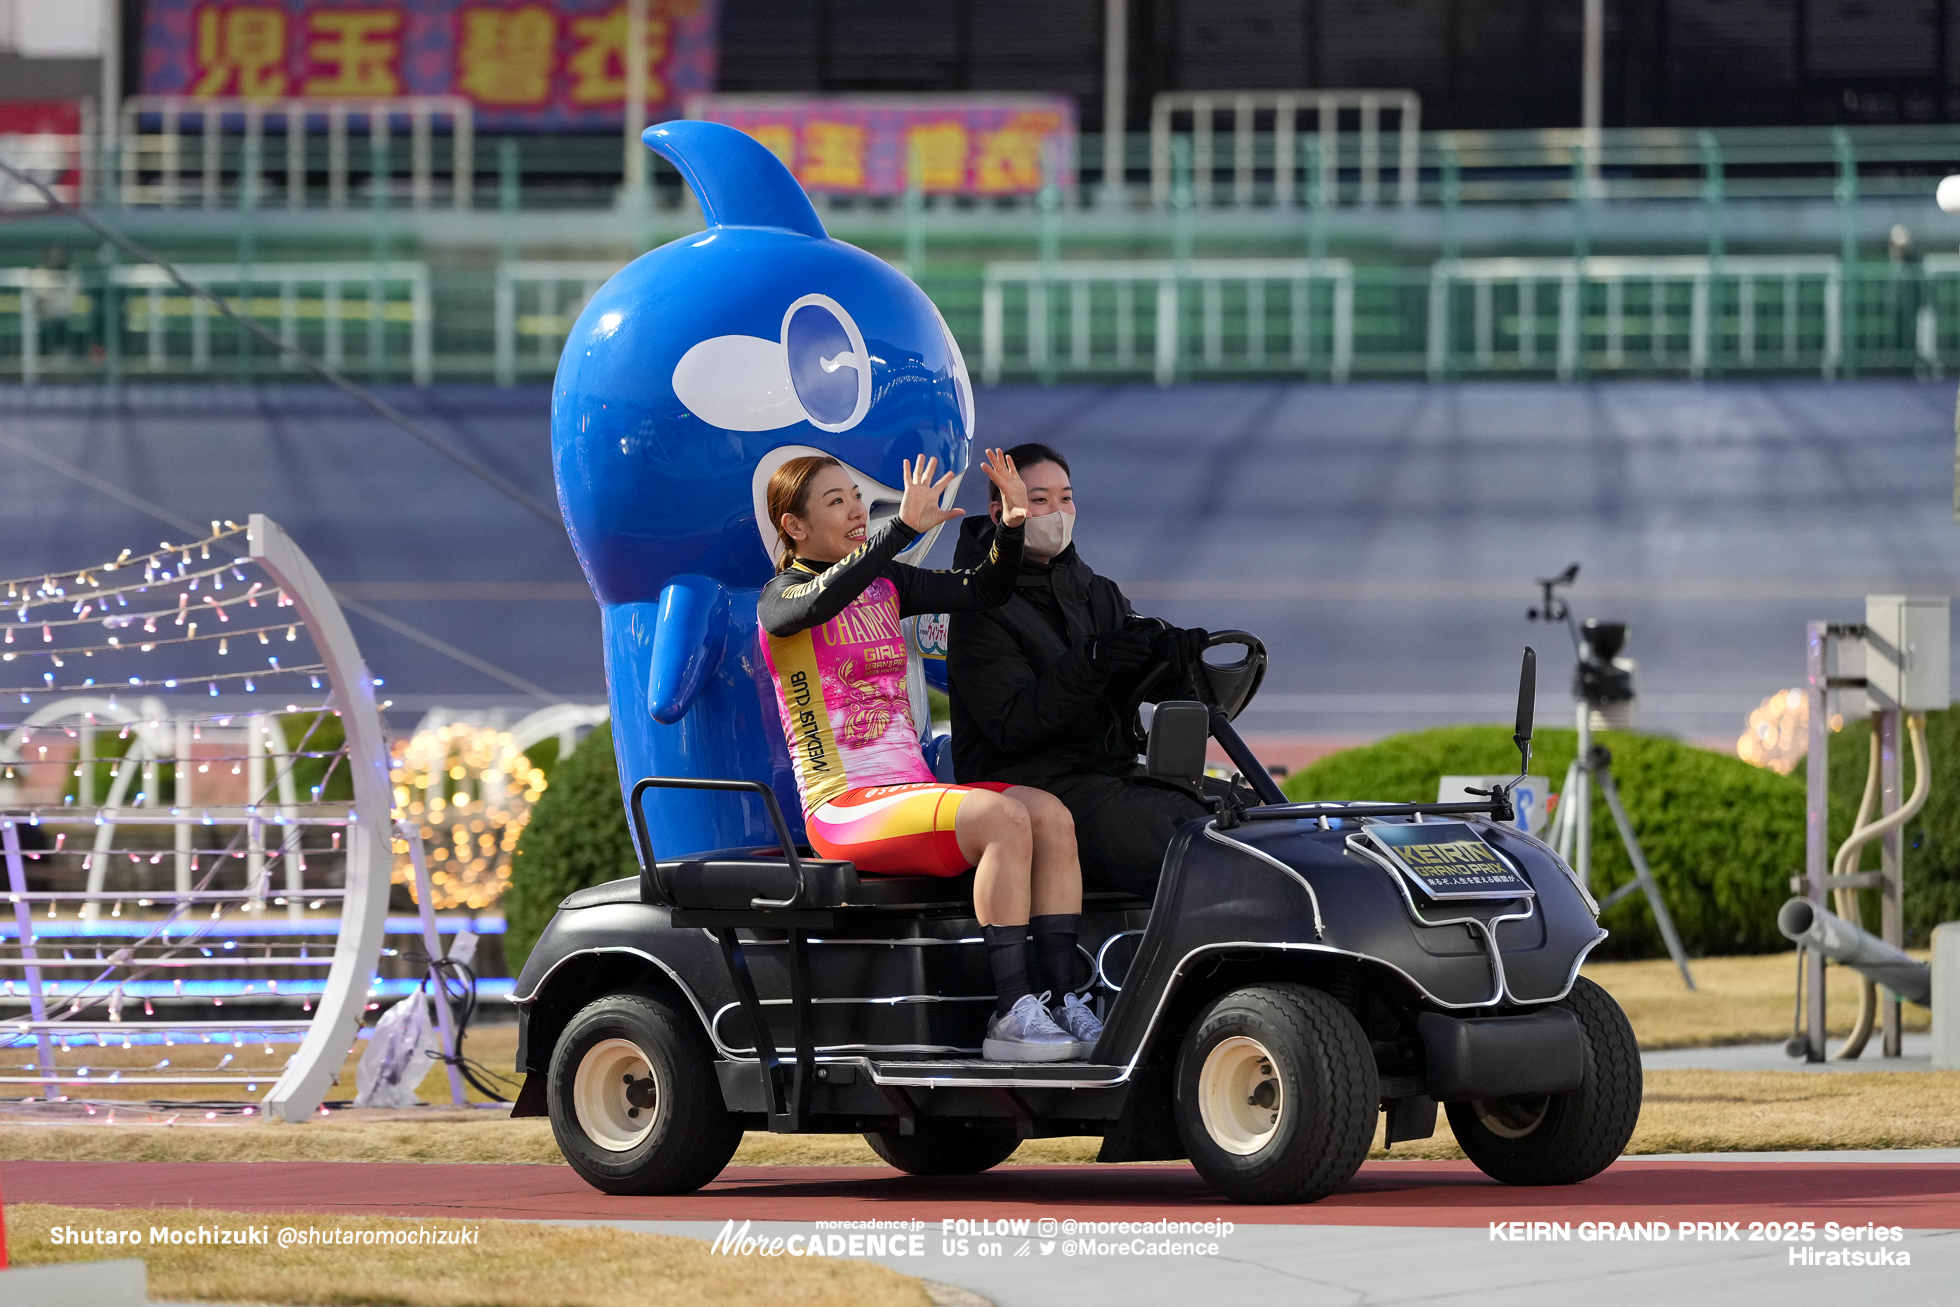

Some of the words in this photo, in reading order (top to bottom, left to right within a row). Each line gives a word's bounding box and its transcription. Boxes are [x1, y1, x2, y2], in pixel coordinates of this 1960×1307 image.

[864, 643, 907, 662] GIRLS
[791, 671, 811, 707] CLUB
[800, 710, 830, 772] MEDALIST
[1392, 843, 1496, 865] KEIRIN
[1413, 865, 1472, 877] GRAND
[1470, 862, 1508, 875] PRIX
